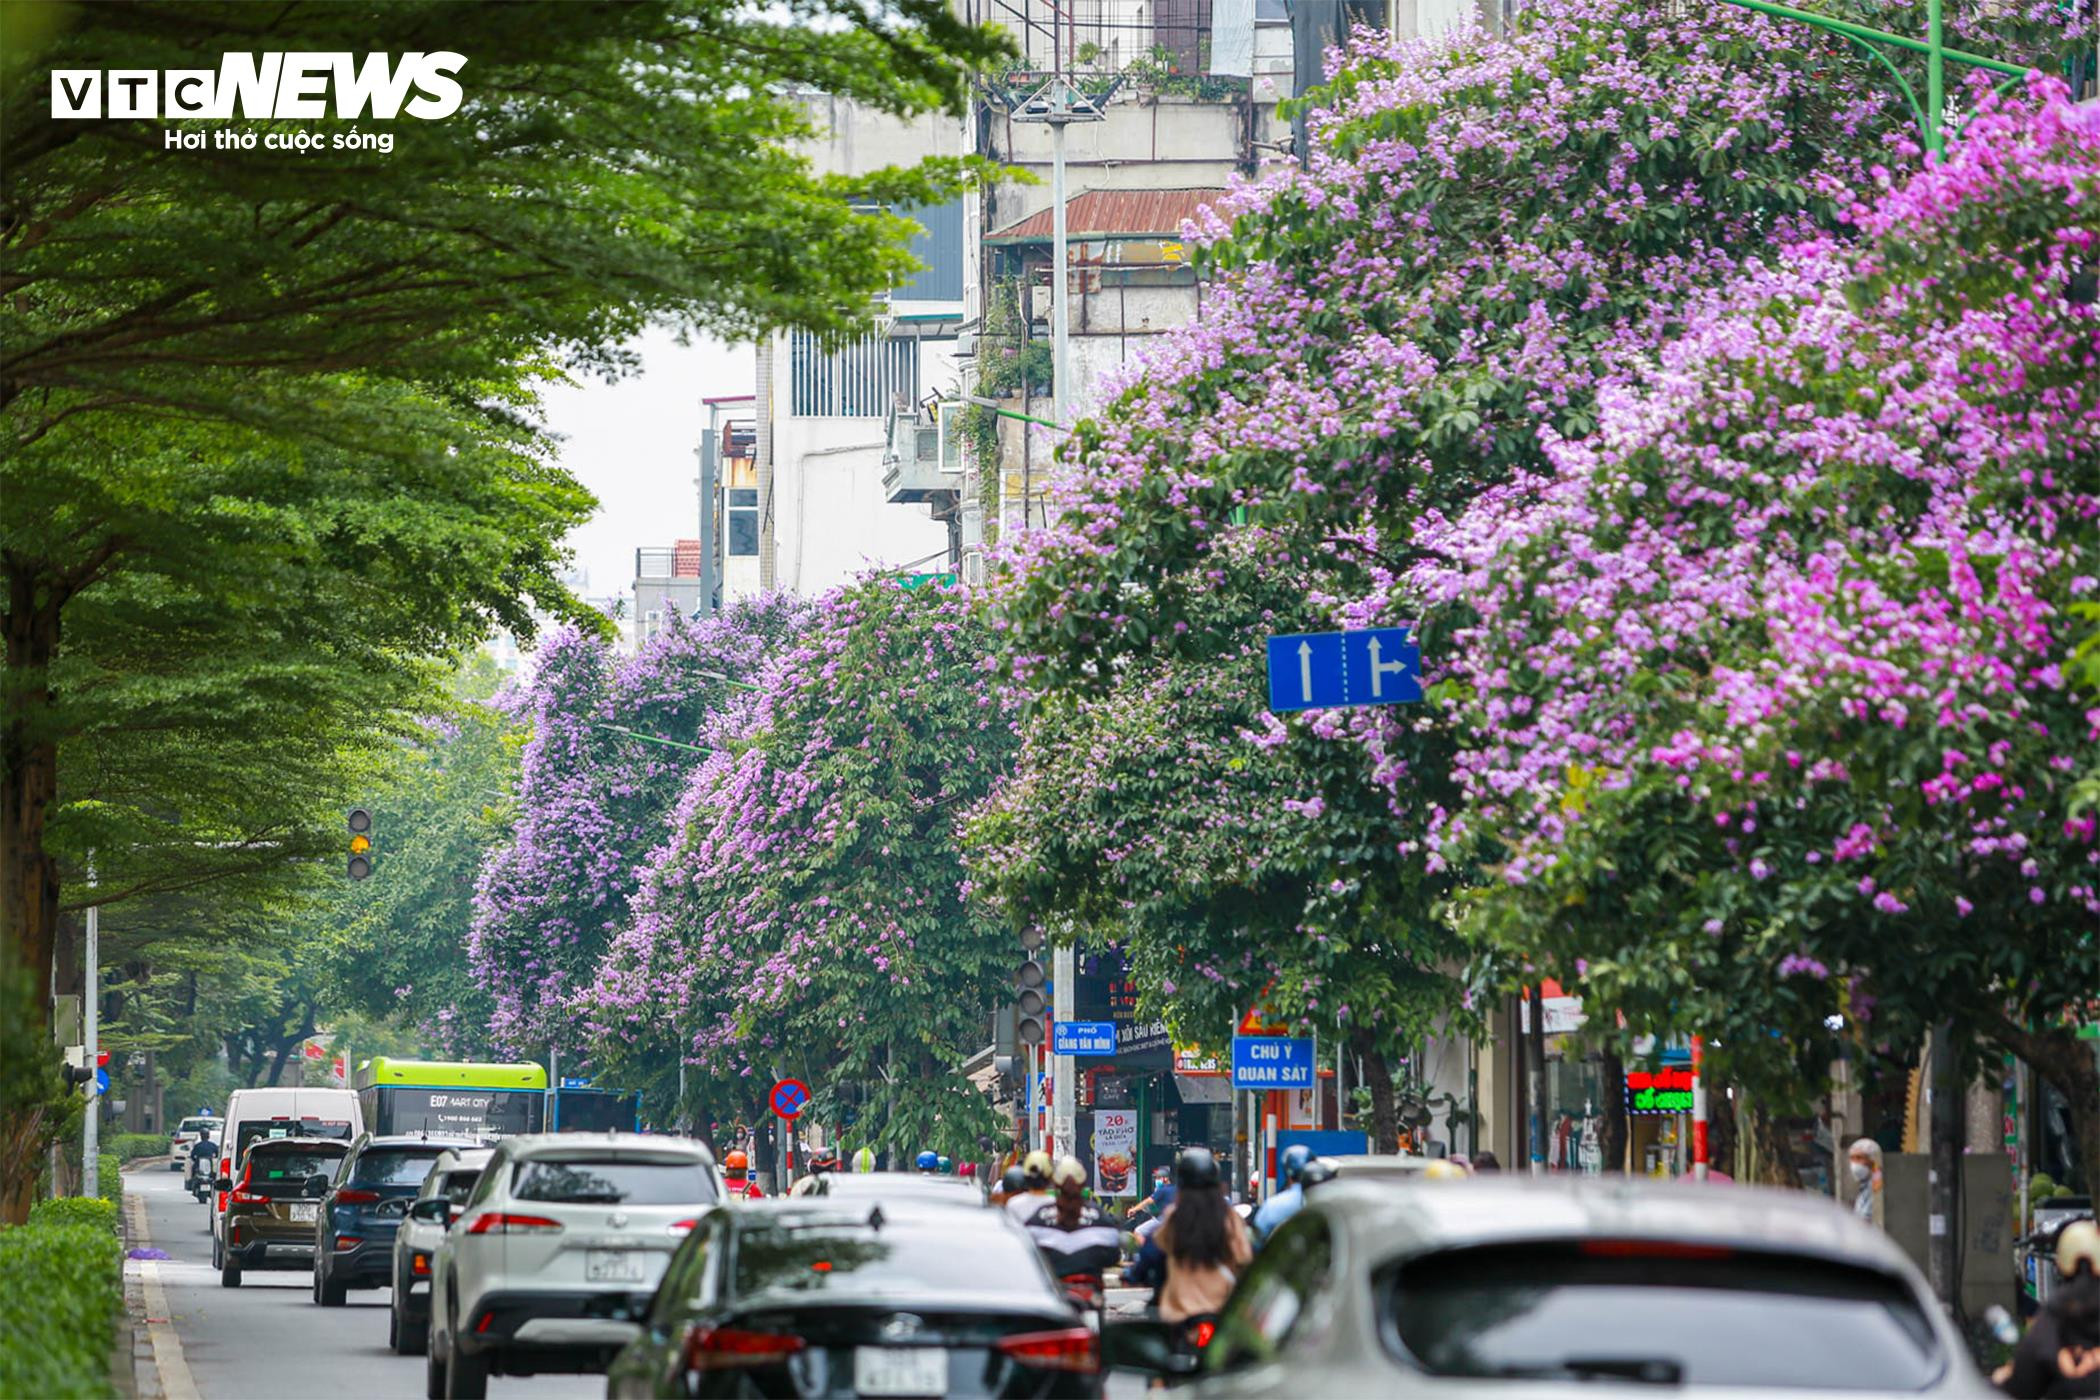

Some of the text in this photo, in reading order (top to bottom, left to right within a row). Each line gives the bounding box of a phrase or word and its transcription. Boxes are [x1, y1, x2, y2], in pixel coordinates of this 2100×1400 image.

[1077, 1025, 1098, 1034] PHỐ
[1250, 1042, 1293, 1060] CHÚ Ý
[1238, 1063, 1309, 1082] QUAN SÁT
[430, 1095, 448, 1108] E07
